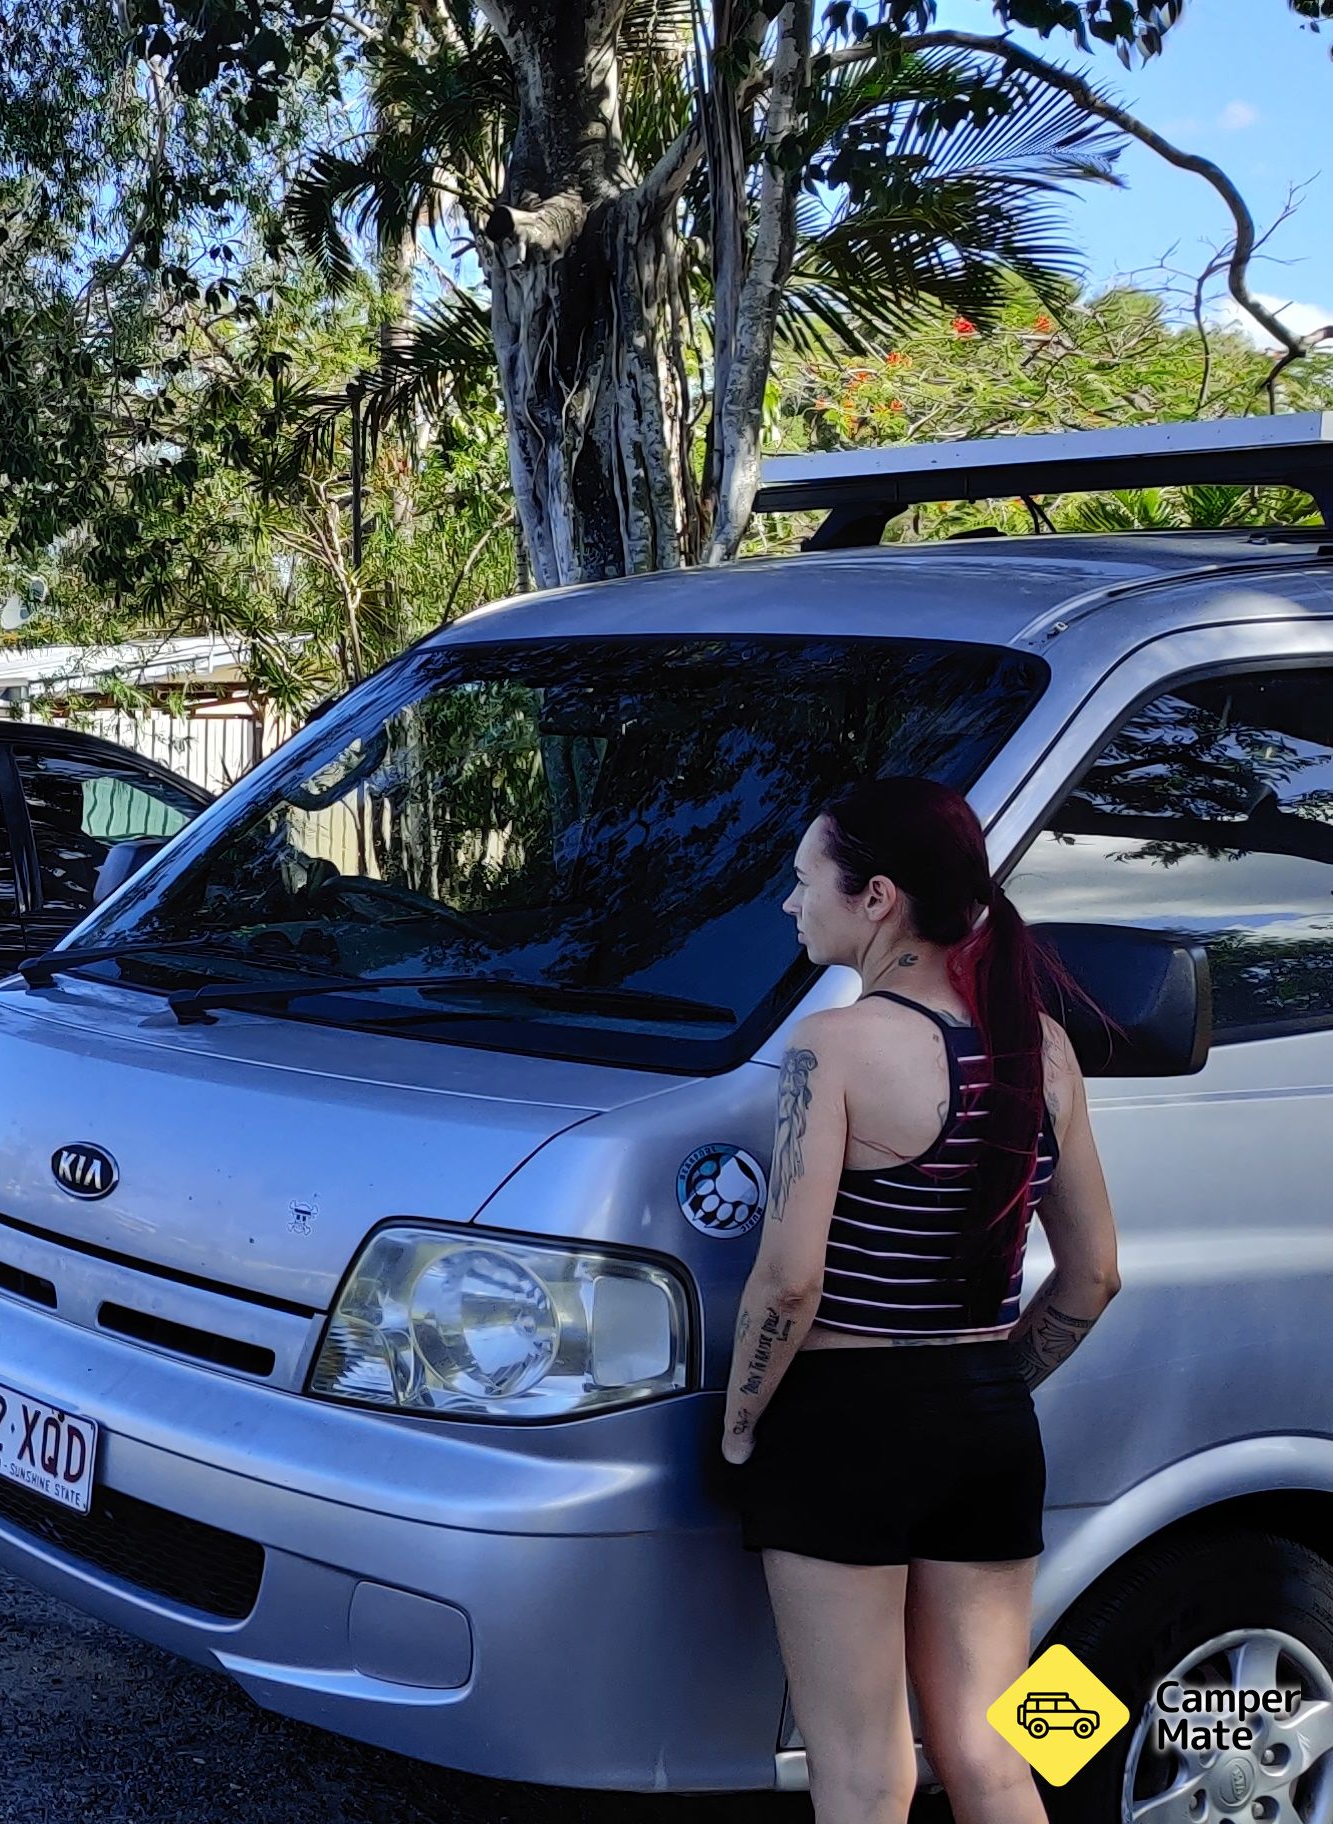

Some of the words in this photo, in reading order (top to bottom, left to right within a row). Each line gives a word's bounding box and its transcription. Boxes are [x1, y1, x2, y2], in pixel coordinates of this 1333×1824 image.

[58, 1150, 103, 1190] KIA
[740, 1206, 763, 1233] MUSIC
[17, 1403, 86, 1484] XQD
[10, 1462, 51, 1493] SUNSHINE
[54, 1483, 81, 1507] STATE
